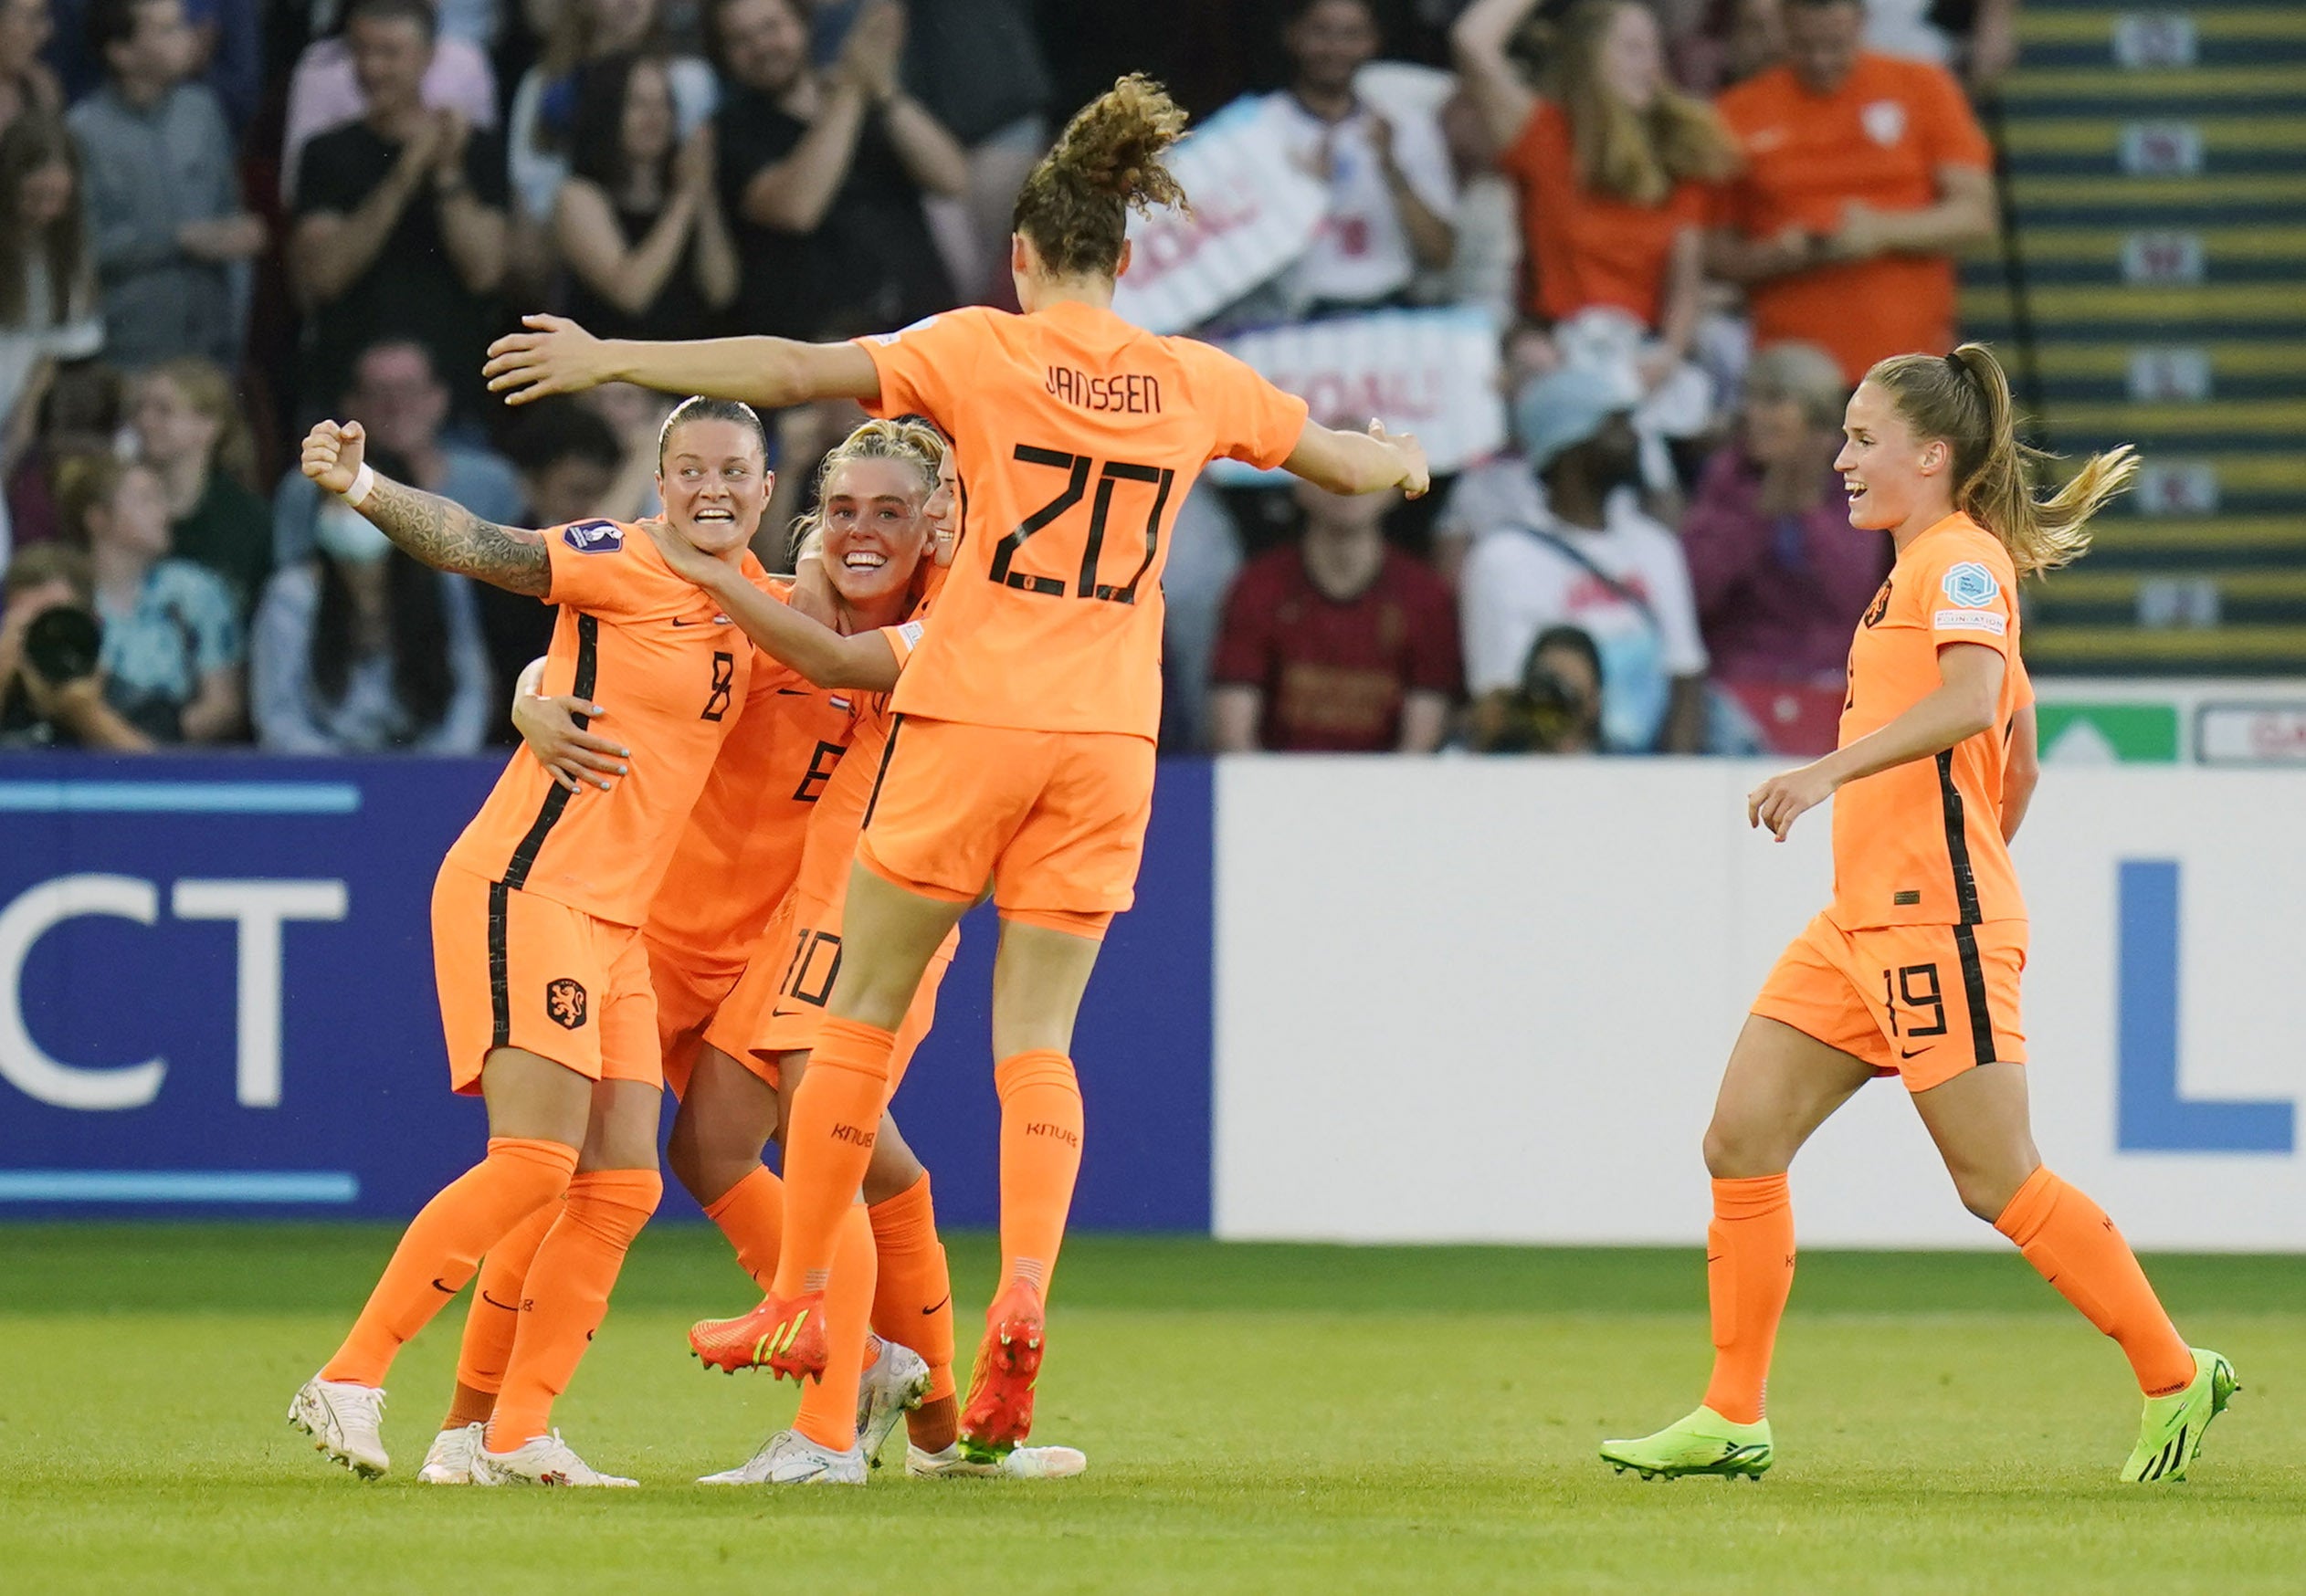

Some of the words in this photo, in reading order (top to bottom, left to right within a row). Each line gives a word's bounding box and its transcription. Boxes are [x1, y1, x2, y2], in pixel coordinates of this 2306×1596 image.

[1046, 365, 1161, 414] JANSSEN
[988, 443, 1175, 605] 20
[700, 651, 733, 722] 8
[0, 871, 351, 1112] CT
[779, 928, 842, 1008] 10
[1883, 962, 1947, 1037] 19
[2113, 858, 2295, 1152] L
